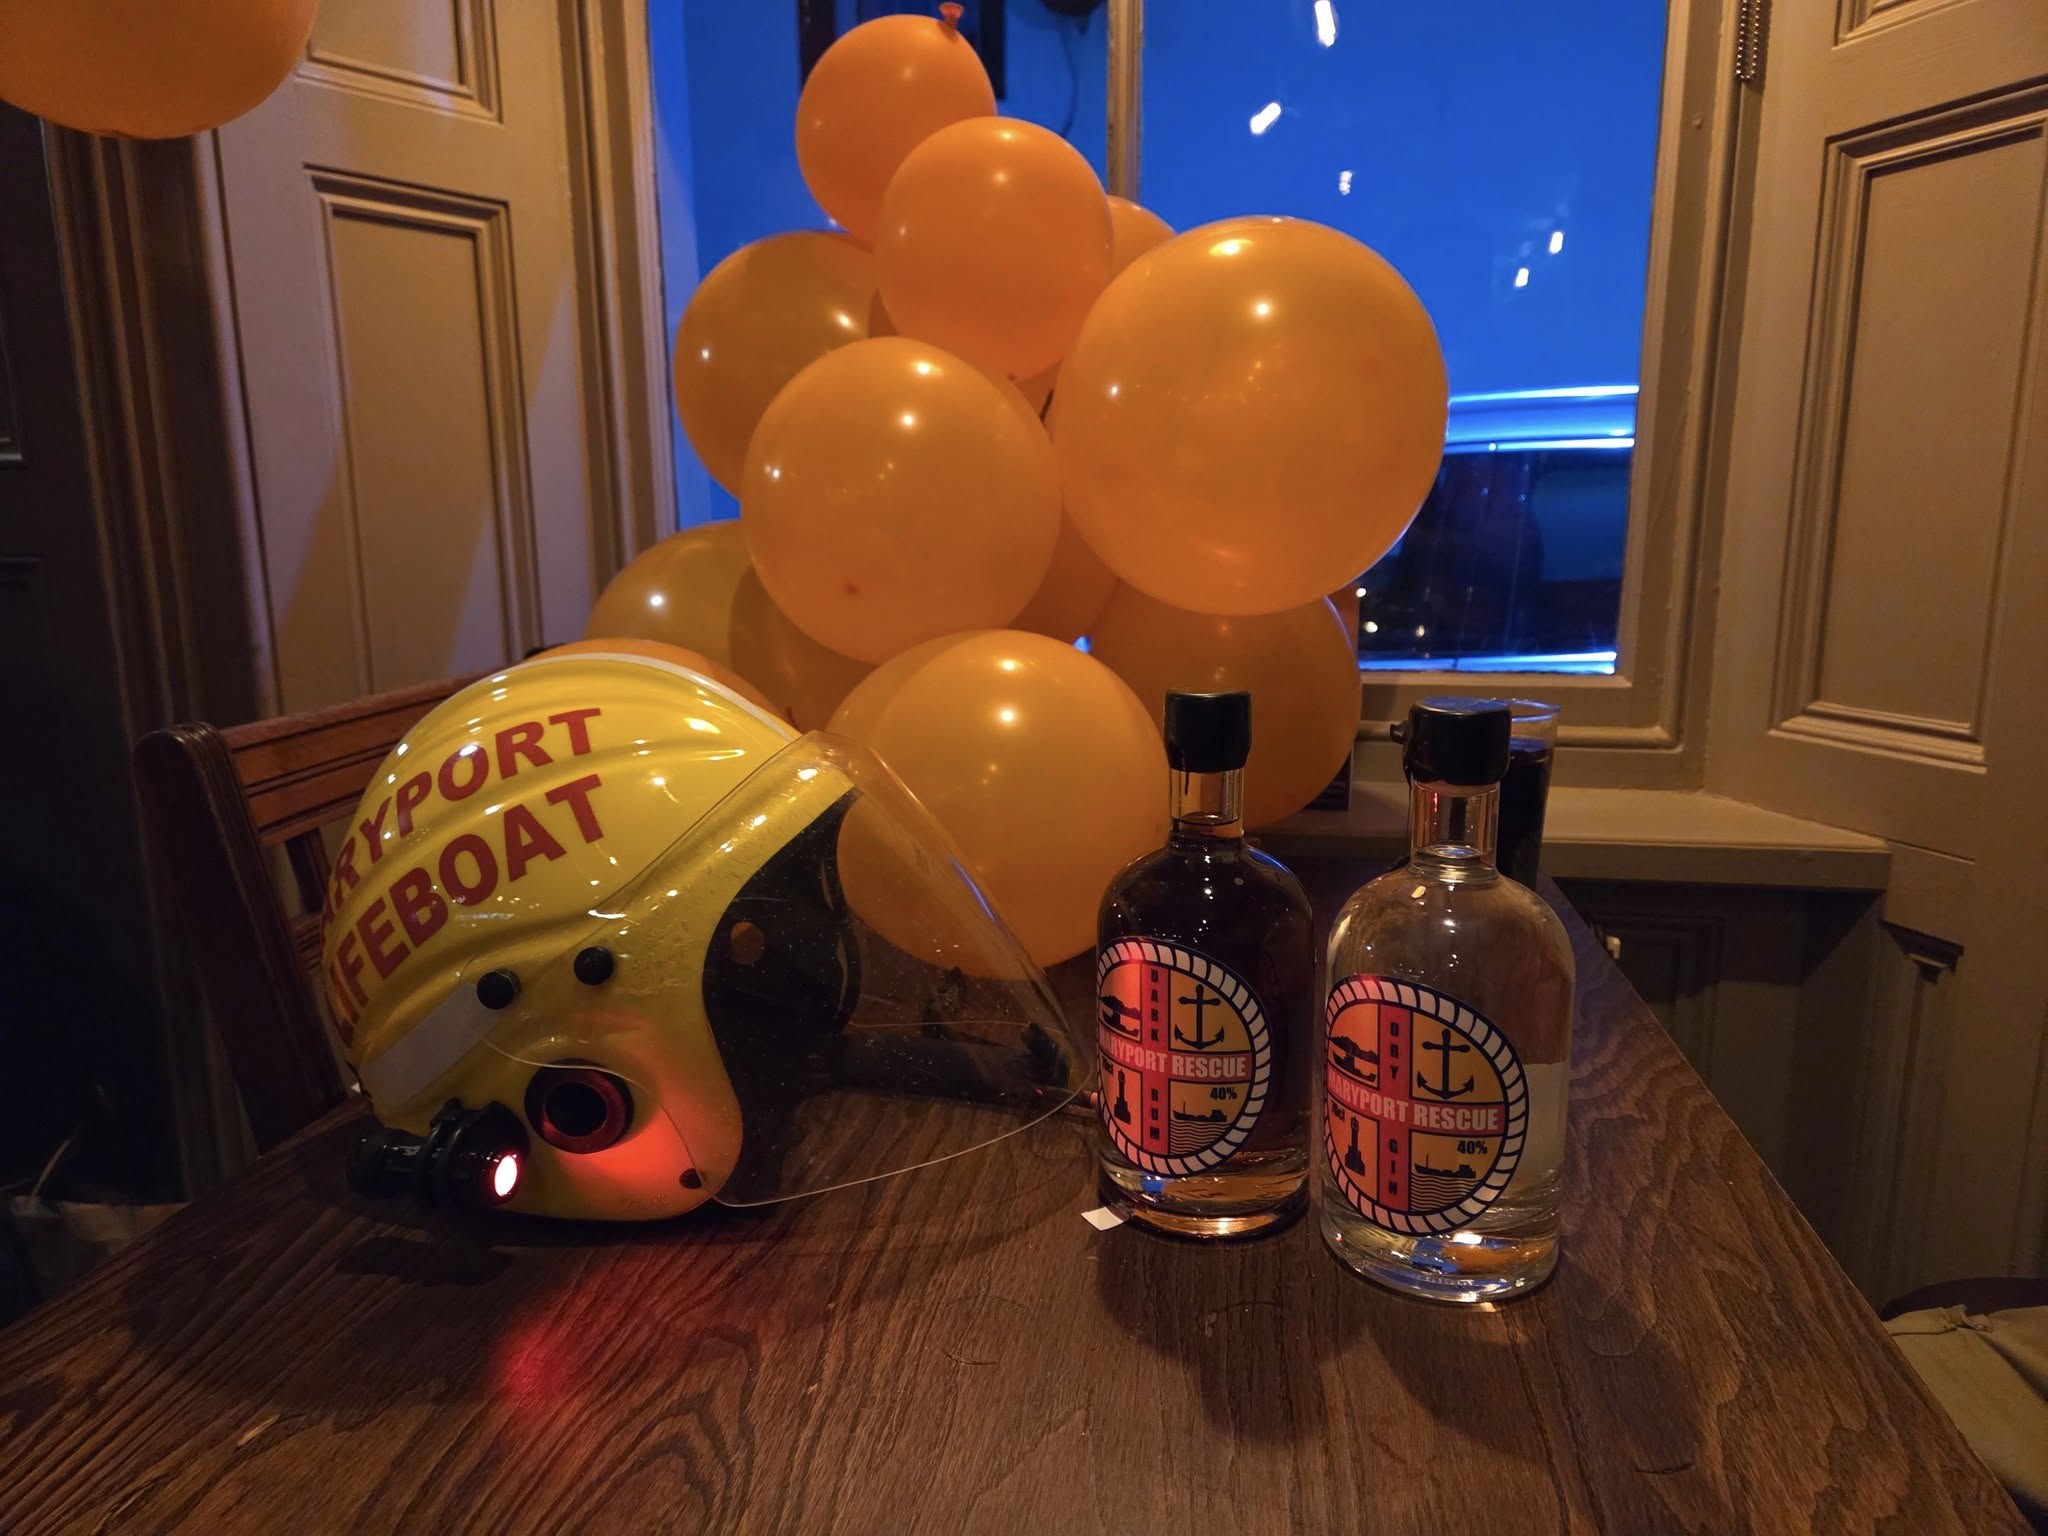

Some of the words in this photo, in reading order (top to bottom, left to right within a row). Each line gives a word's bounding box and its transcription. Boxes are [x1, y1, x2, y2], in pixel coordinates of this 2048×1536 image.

[1150, 968, 1160, 1043] DARK
[1171, 1055, 1247, 1079] RESCUE
[1389, 1021, 1400, 1081] DRY
[1149, 1088, 1161, 1141] RUM
[1210, 1086, 1238, 1101] 40%
[1328, 1067, 1409, 1123] MARYPORT
[1413, 1103, 1499, 1132] RESCUE
[1388, 1138, 1399, 1196] GIN
[1456, 1139, 1488, 1155] 40%
